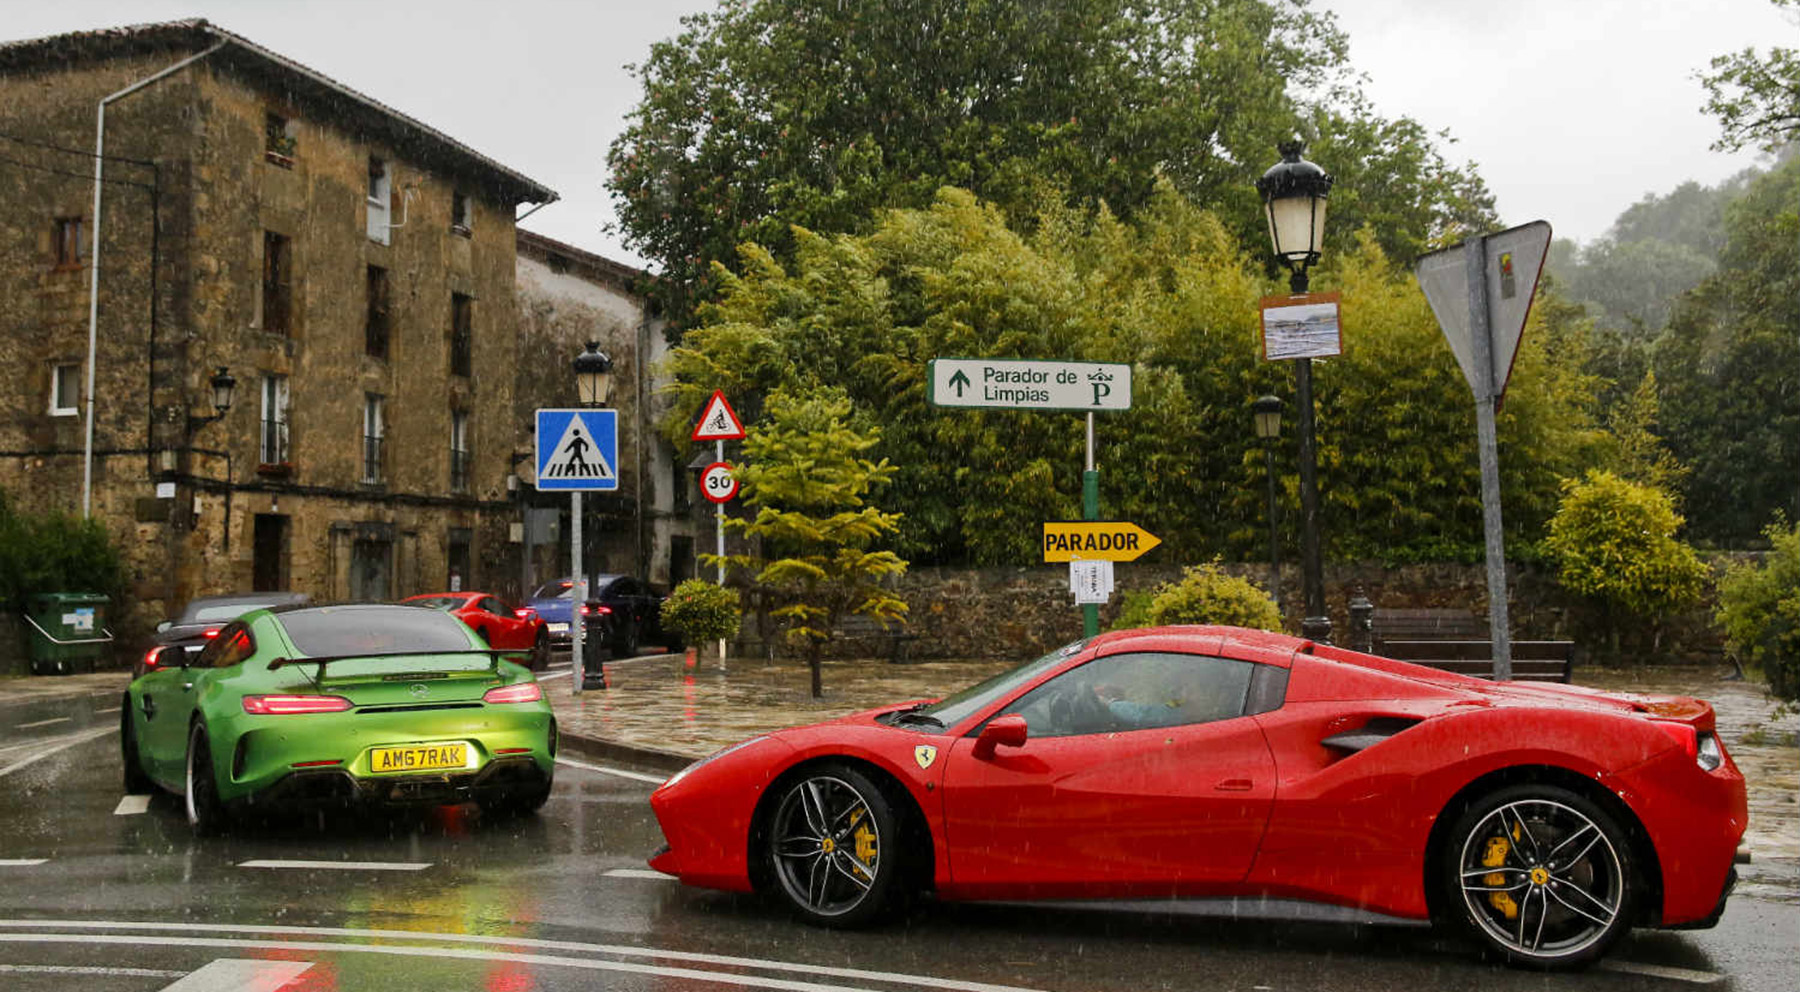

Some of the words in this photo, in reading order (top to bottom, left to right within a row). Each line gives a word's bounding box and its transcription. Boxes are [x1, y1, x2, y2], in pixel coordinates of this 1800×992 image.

[983, 367, 1049, 383] Parador
[1056, 368, 1078, 384] de
[984, 386, 1049, 404] Limpias
[1091, 382, 1111, 405] P
[708, 475, 731, 489] 30
[1045, 532, 1140, 551] PARADOR
